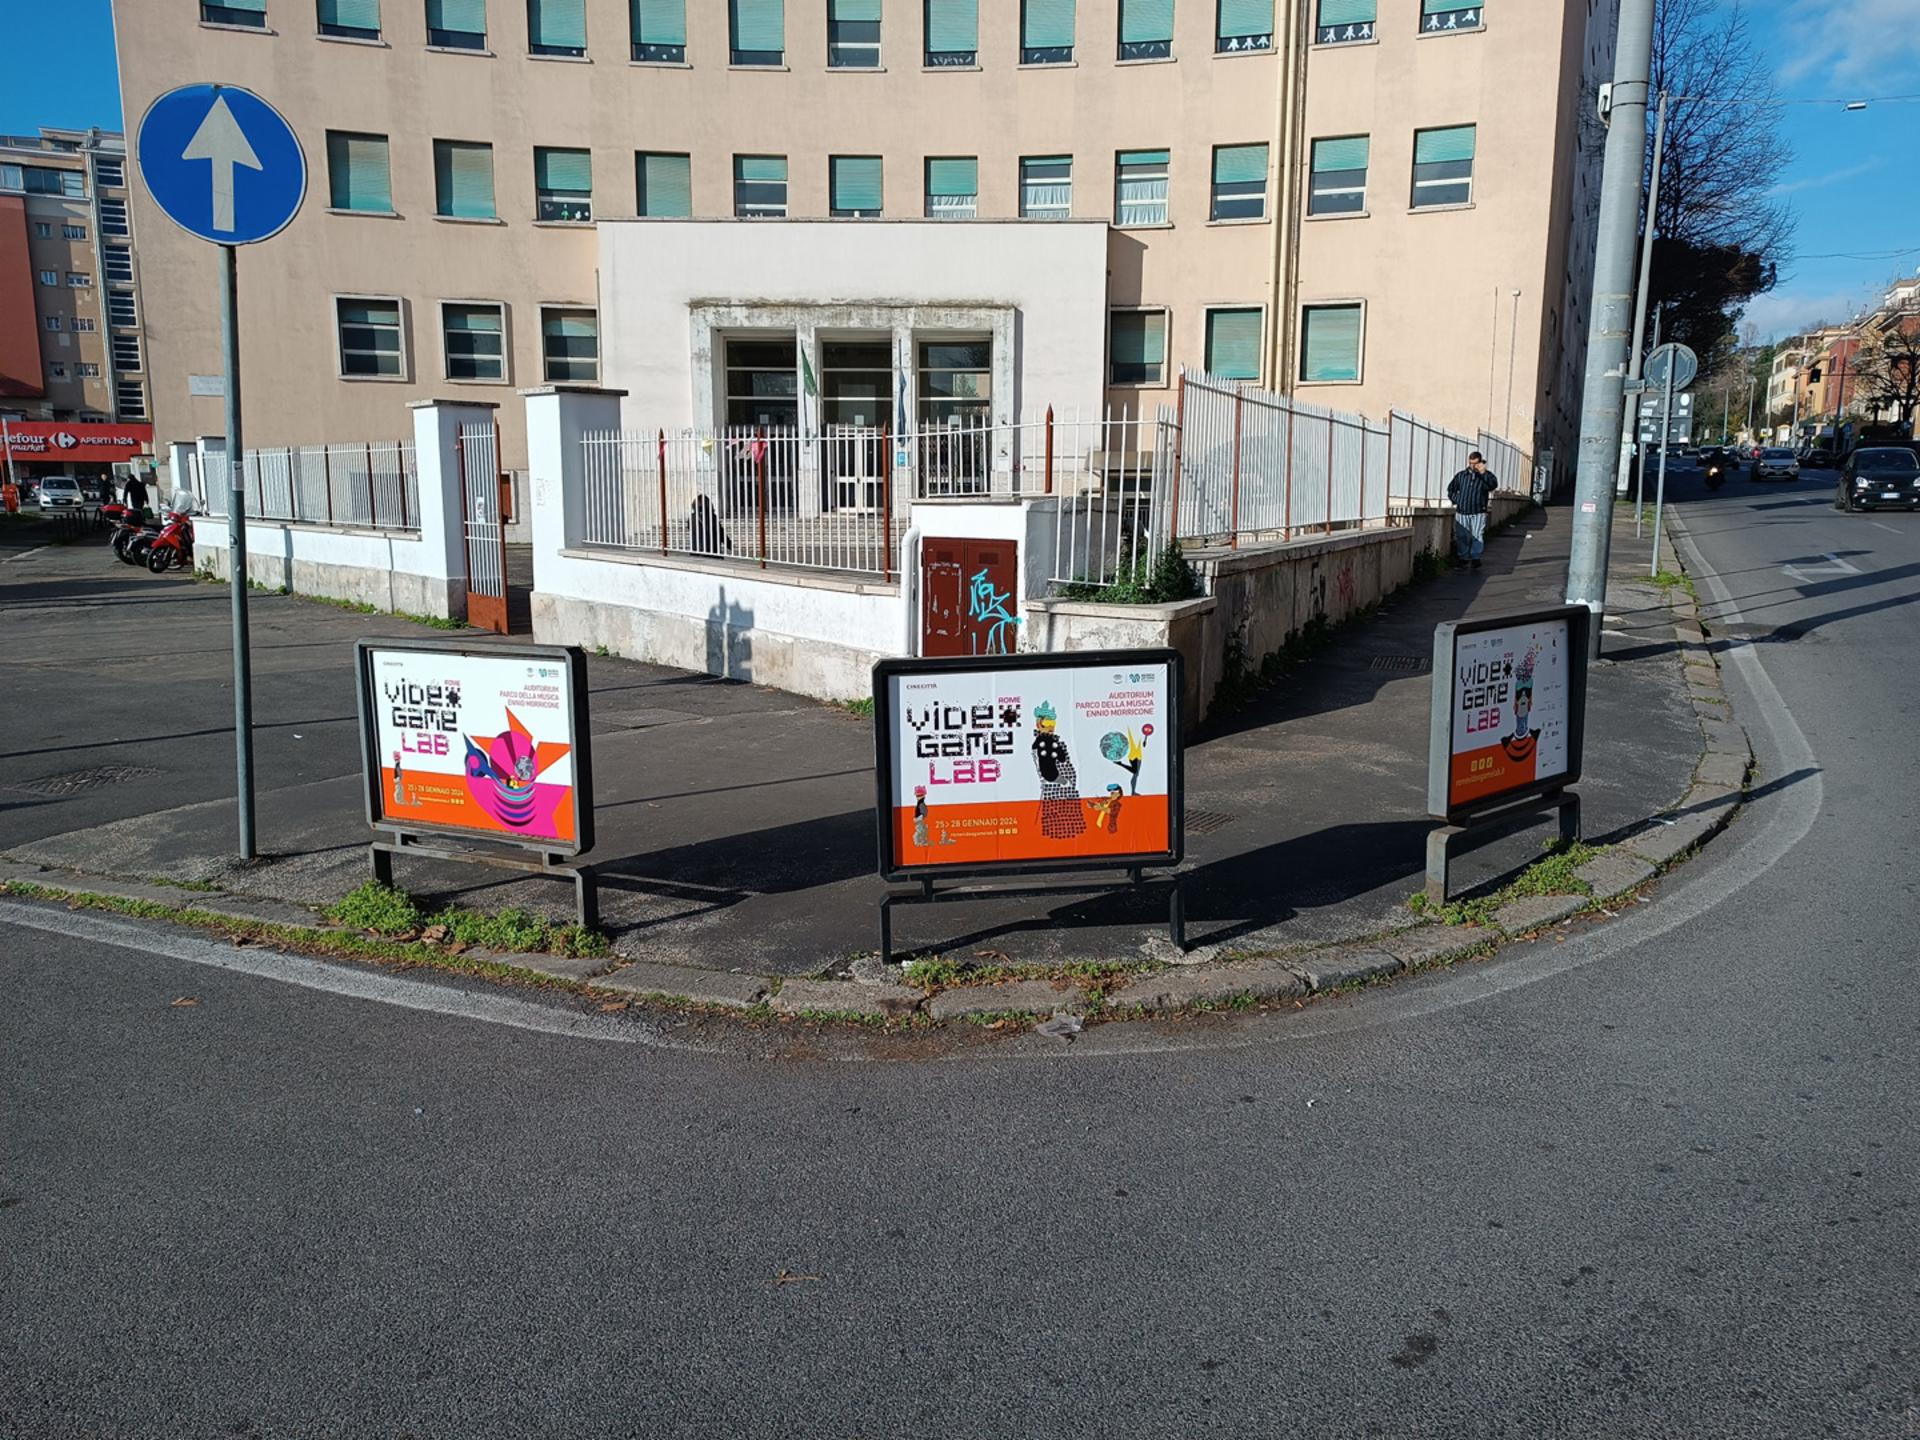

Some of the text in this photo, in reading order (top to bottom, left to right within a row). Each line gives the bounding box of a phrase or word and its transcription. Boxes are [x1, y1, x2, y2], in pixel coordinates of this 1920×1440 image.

[114, 437, 133, 445] h24
[11, 443, 45, 452] market
[523, 684, 560, 693] AUDITORIUM
[519, 692, 537, 700] DELLA
[537, 693, 560, 701] MUSICA
[998, 696, 1021, 704] ROME
[1108, 691, 1154, 700] AUDITORIUM
[1075, 699, 1155, 710] PARCO DELLA MUSICA
[1086, 707, 1155, 718] ENNIO MORRICONE
[951, 819, 961, 828] 28
[962, 817, 998, 828] GENNAIO
[999, 816, 1018, 826] 2024
